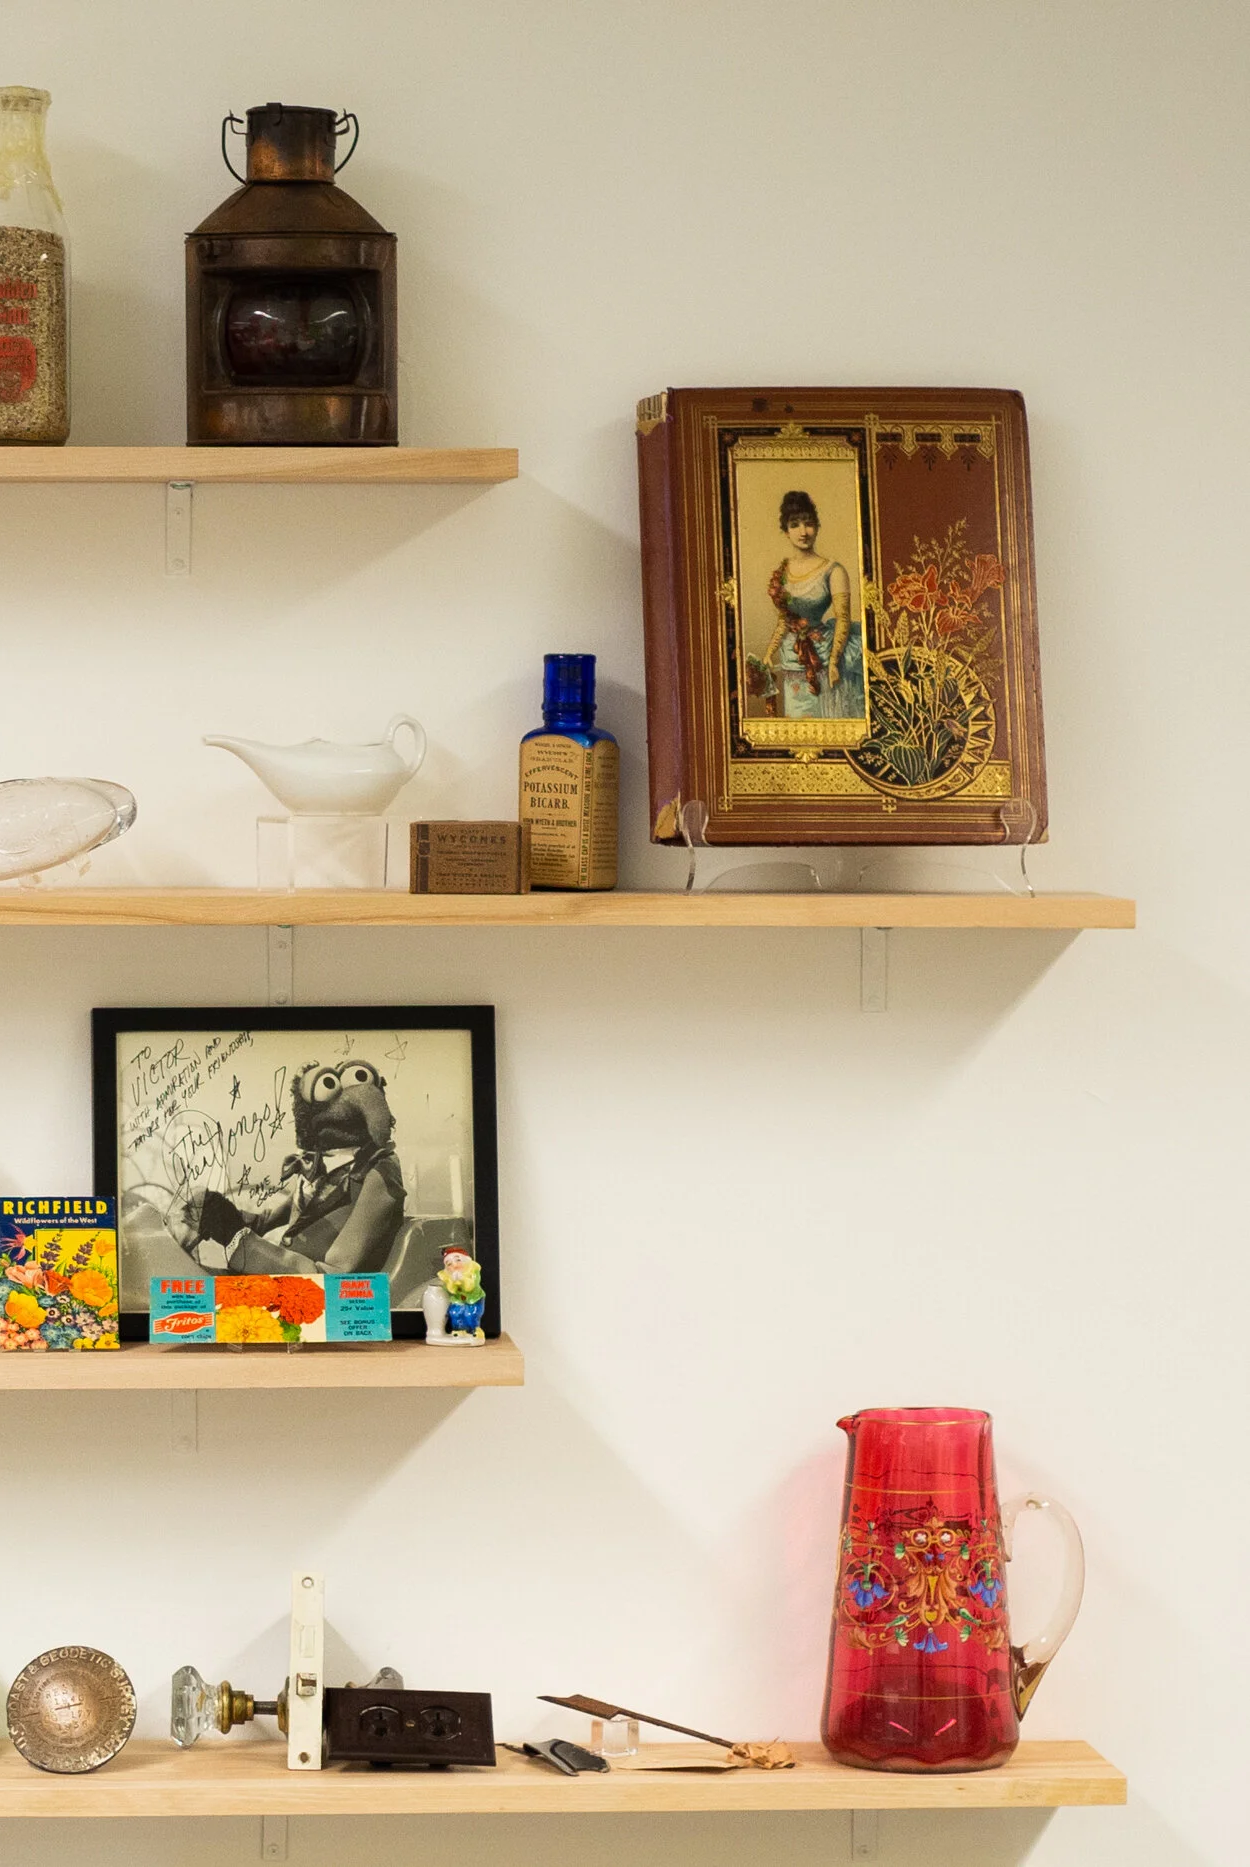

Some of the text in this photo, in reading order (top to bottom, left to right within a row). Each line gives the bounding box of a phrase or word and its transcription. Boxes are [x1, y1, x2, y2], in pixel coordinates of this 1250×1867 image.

[524, 764, 579, 780] EFFERVESCENT
[524, 781, 578, 795] POTASSIUM
[530, 797, 570, 809] BICARB.
[131, 1046, 151, 1070] TO
[132, 1038, 190, 1106] VICTOR
[130, 1106, 151, 1132] WITH
[3, 1200, 108, 1215] RICHFIELD
[13, 1217, 59, 1225] Wildflowers
[160, 1279, 205, 1294] FREE
[164, 1317, 205, 1332] Fritos
[28, 1663, 40, 1675] &
[38, 1647, 112, 1669] GEODETIC
